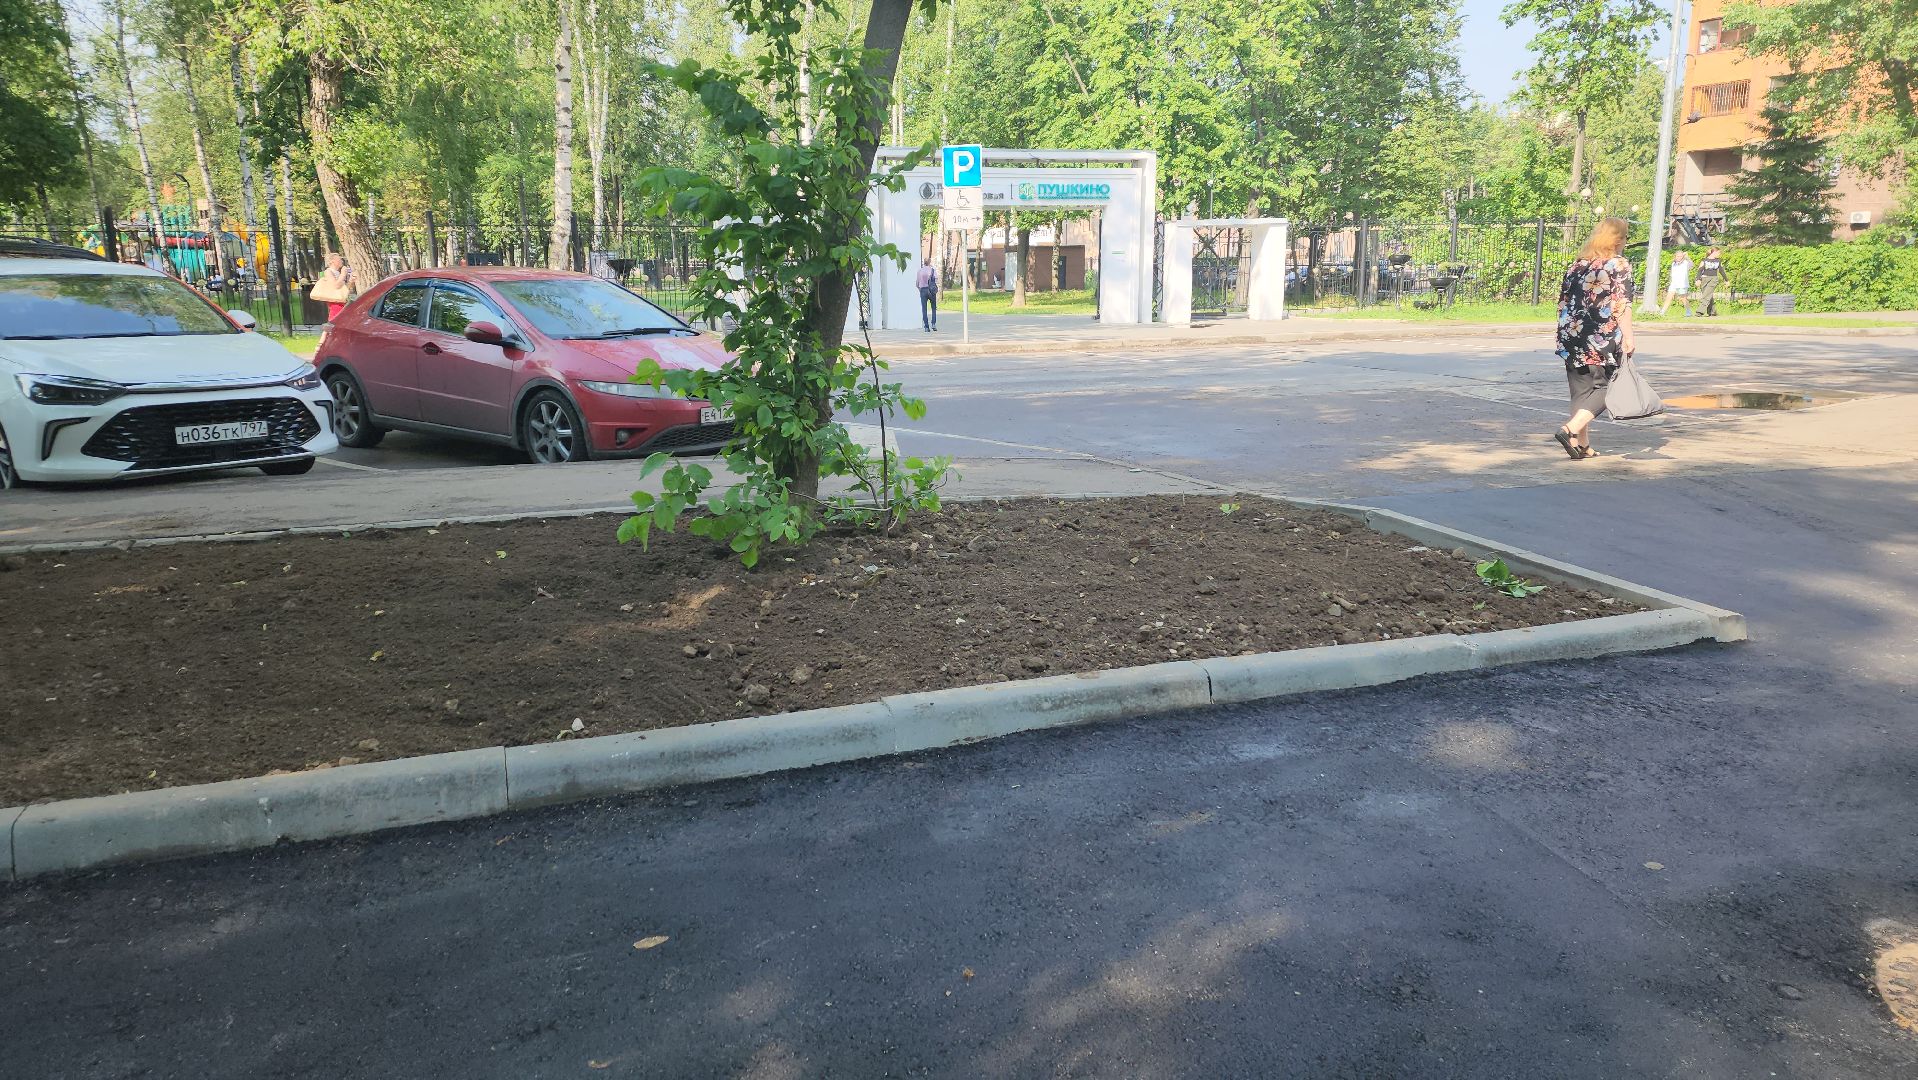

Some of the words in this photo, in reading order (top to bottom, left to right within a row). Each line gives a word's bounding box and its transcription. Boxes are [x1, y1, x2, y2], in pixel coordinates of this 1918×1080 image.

[953, 150, 975, 183] P
[1037, 183, 1111, 195] ПУШКИНО
[241, 421, 263, 434] 797
